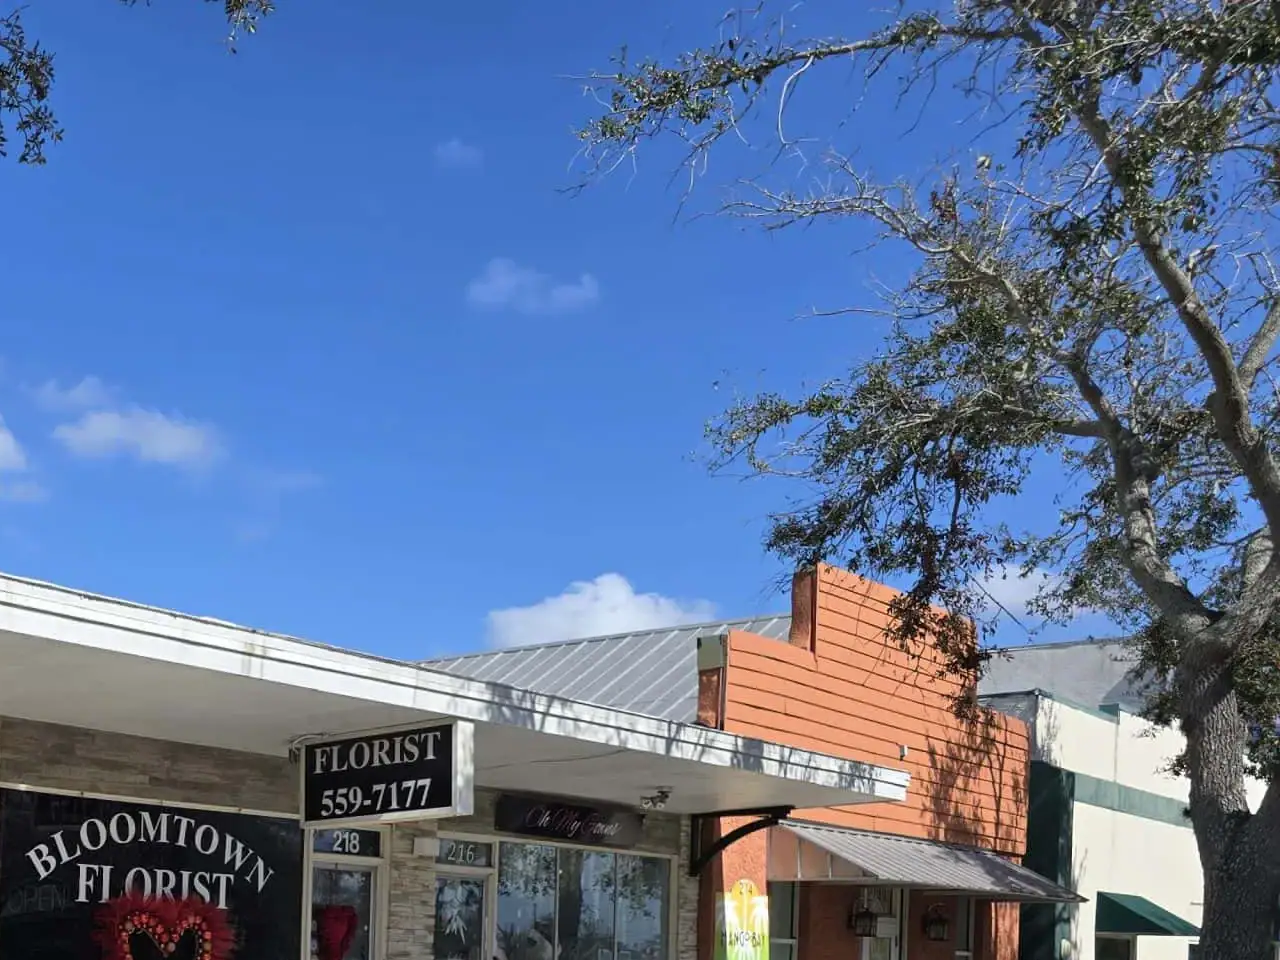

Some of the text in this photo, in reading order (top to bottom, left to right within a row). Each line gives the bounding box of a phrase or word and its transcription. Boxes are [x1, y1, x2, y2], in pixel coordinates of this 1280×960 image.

[313, 731, 441, 774] FLORIST
[320, 777, 432, 817] 559-7177
[24, 810, 275, 893] BLOOMTOWN
[332, 830, 360, 854] 218
[447, 841, 475, 864] 216
[7, 883, 66, 913] OPEN
[75, 862, 235, 910] FLORIST
